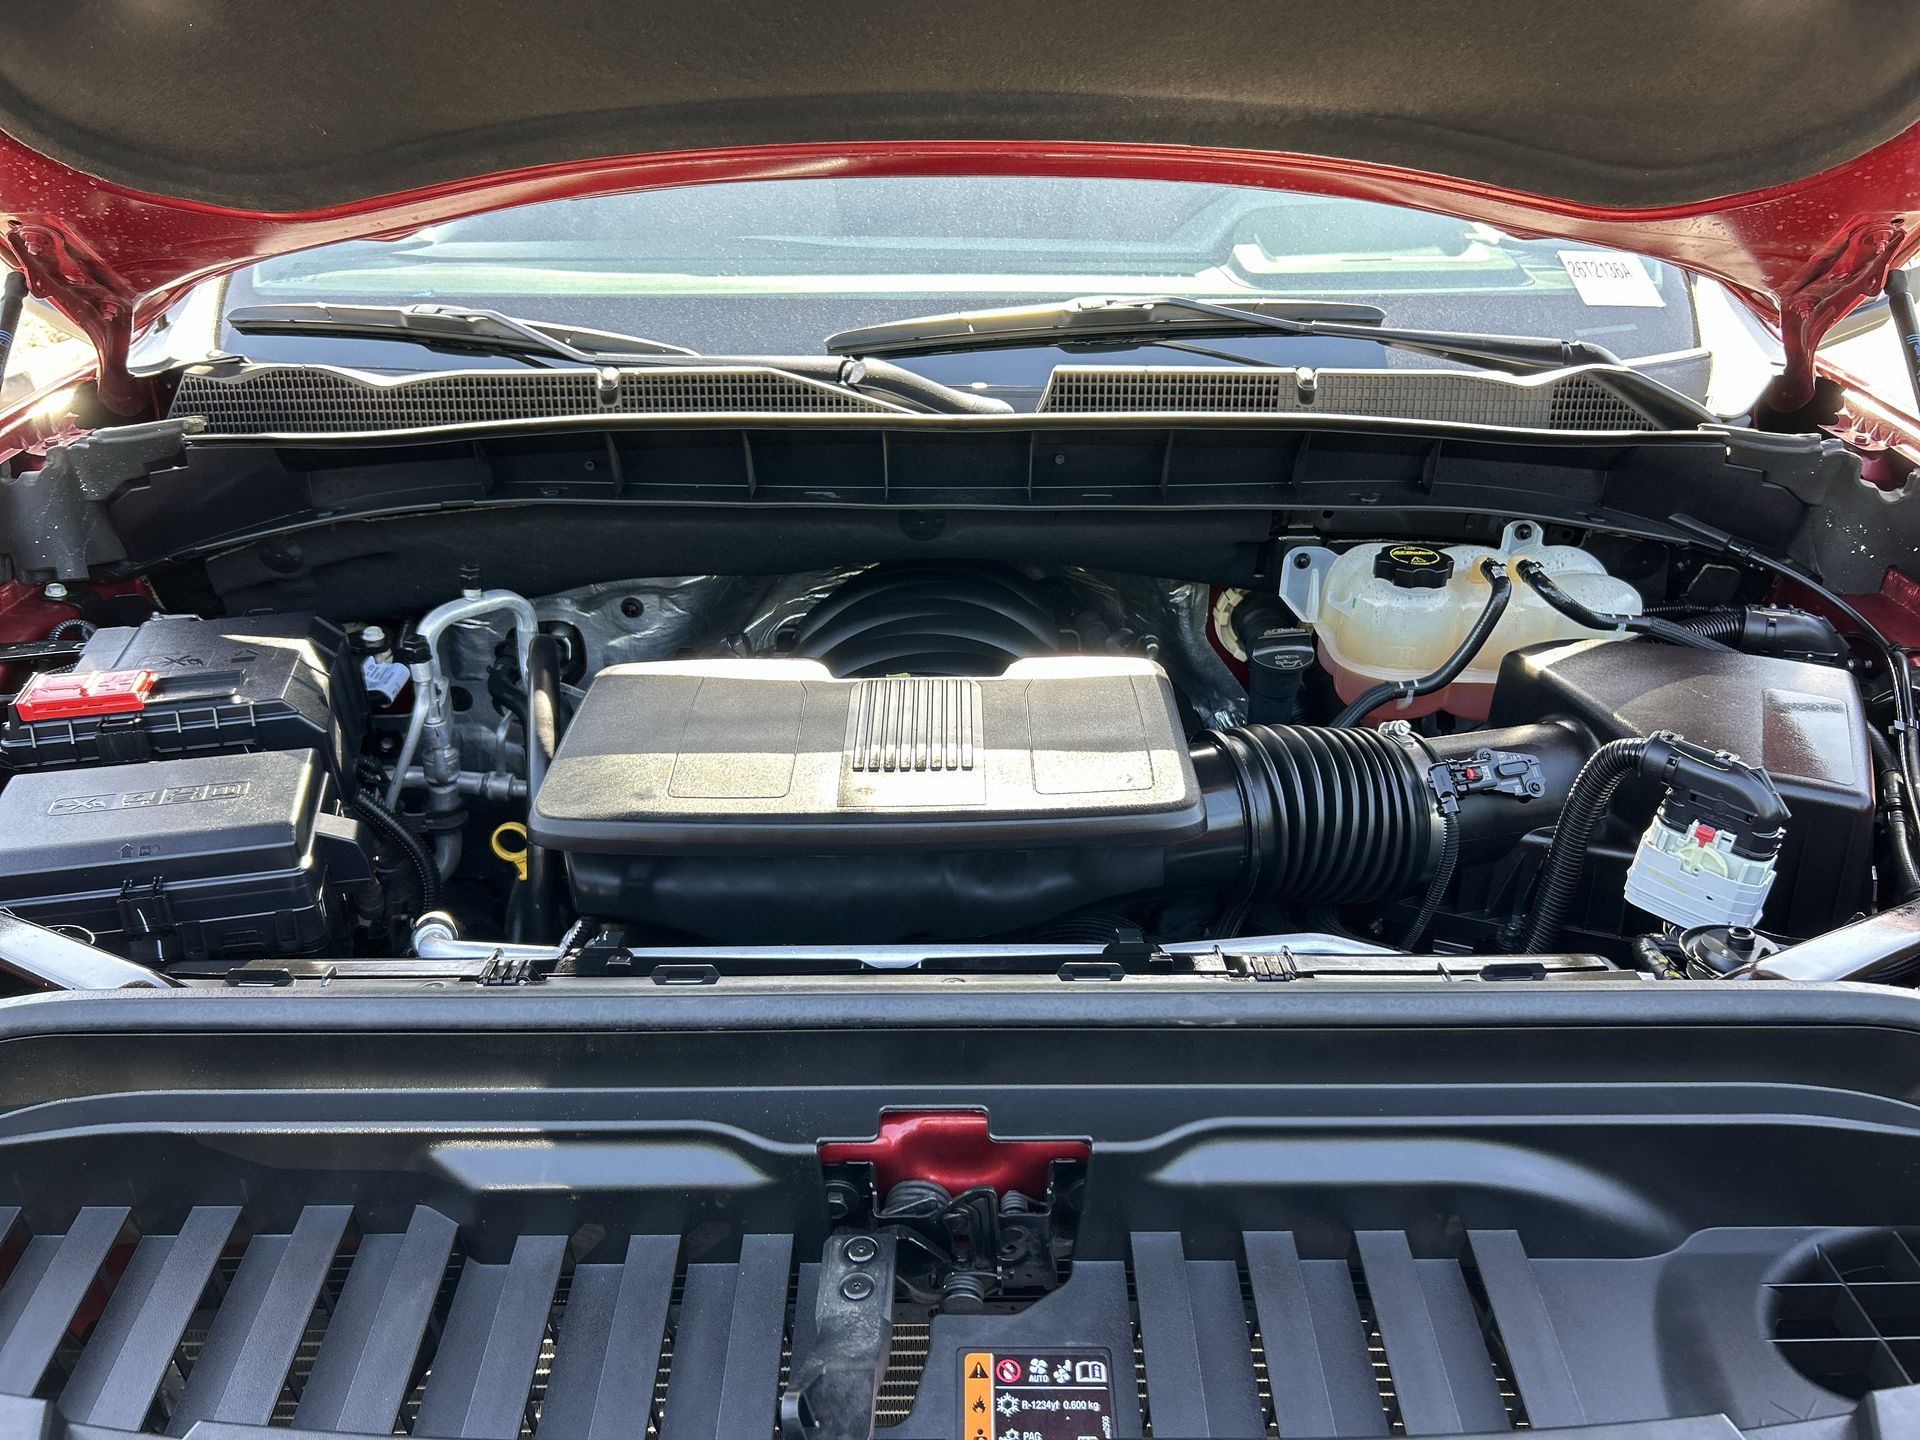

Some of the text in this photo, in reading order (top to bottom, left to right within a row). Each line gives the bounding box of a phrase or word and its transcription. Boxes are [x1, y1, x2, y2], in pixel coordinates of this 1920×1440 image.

[1567, 260, 1633, 279] 26T2136A
[1028, 1374, 1049, 1383] AUTO
[1062, 1400, 1087, 1410] 0.600
[1088, 1400, 1101, 1411] kg
[1023, 1431, 1042, 1440] PAG
